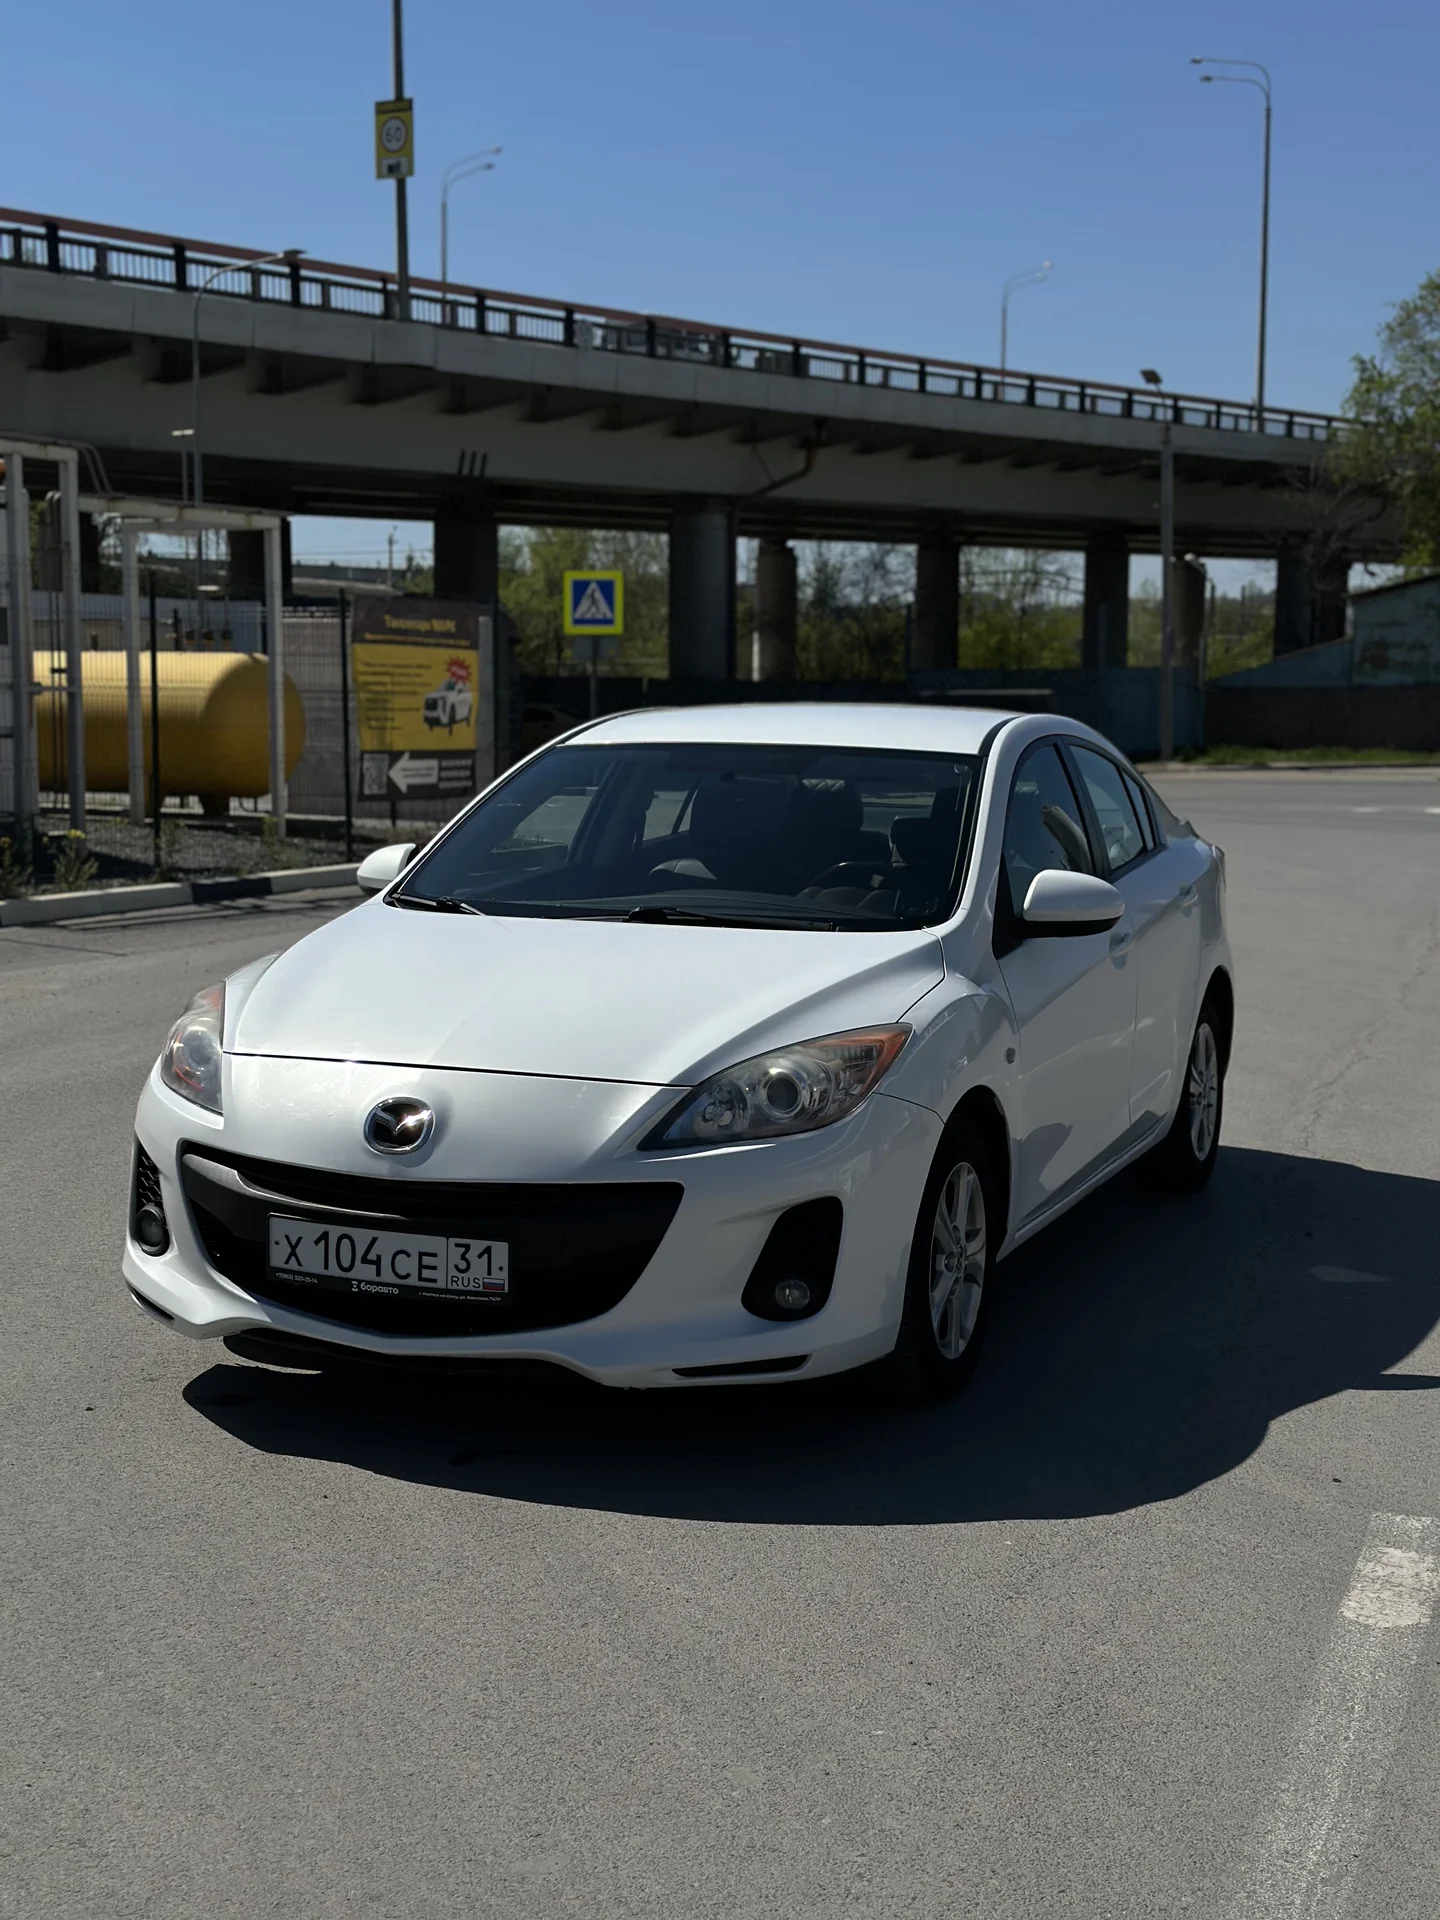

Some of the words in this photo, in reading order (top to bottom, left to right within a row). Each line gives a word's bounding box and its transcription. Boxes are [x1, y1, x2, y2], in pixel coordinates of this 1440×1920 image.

[454, 1243, 492, 1276] 31
[360, 1281, 399, 1295] боравто
[451, 1275, 481, 1289] RUS
